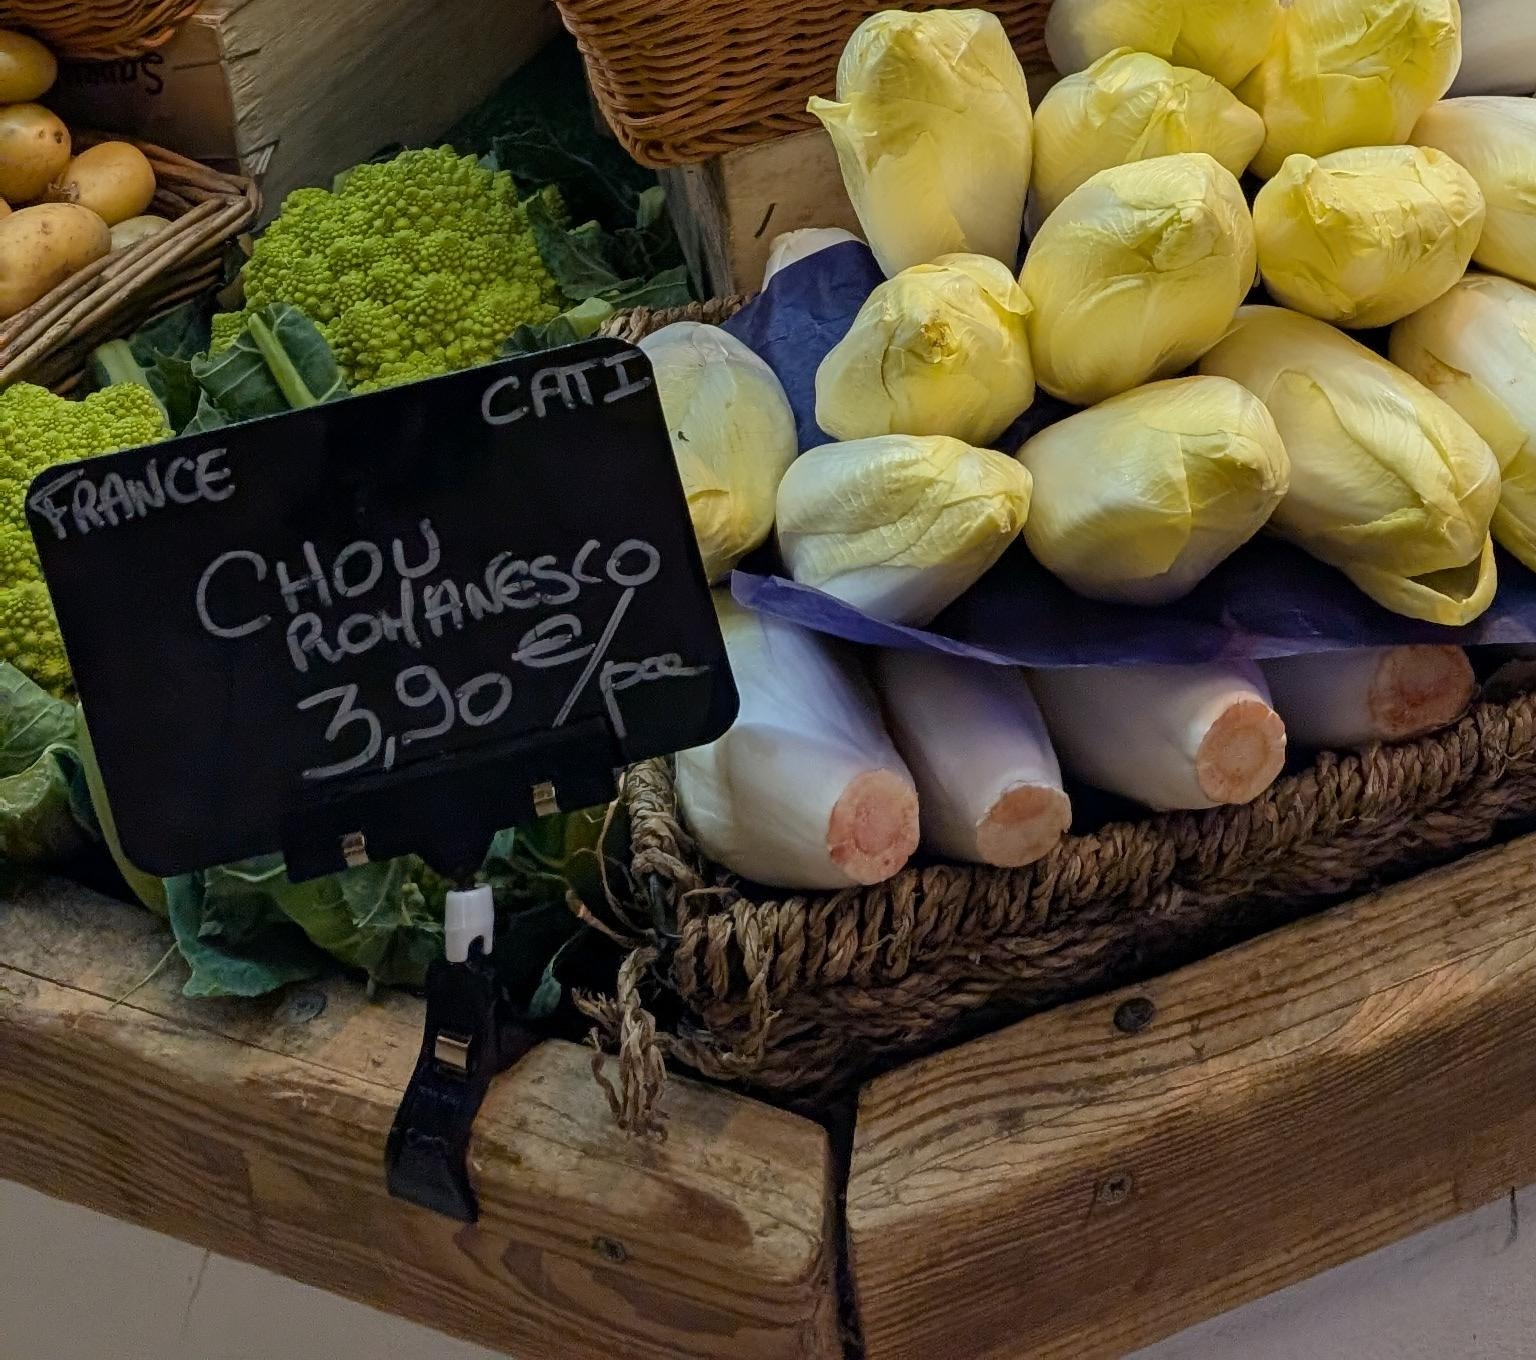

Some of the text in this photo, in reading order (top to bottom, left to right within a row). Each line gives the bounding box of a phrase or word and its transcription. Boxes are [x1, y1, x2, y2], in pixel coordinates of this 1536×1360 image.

[30, 447, 236, 540] FRANCE
[196, 517, 441, 640] CHOU
[285, 537, 661, 674] ROMANESCO
